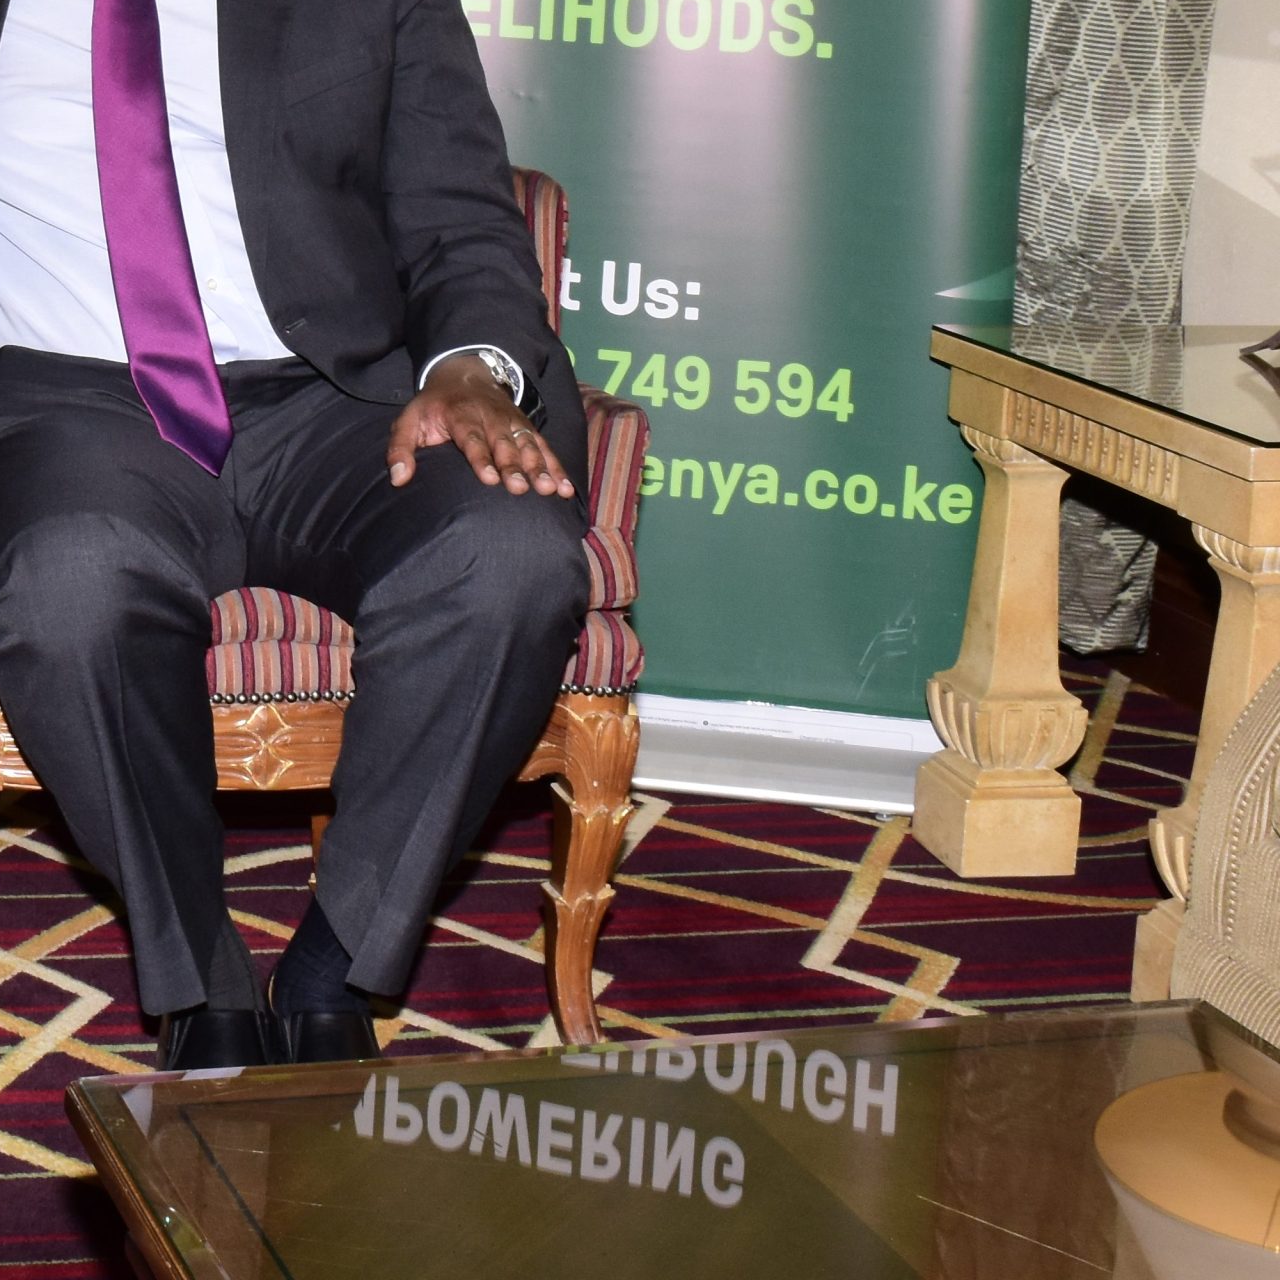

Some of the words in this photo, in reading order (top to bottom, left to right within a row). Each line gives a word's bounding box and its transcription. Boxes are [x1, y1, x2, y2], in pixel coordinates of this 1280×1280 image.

[601, 260, 701, 321] Us:
[597, 348, 711, 410] 749
[734, 364, 855, 424] 594
[638, 453, 974, 525] enya.co.ke
